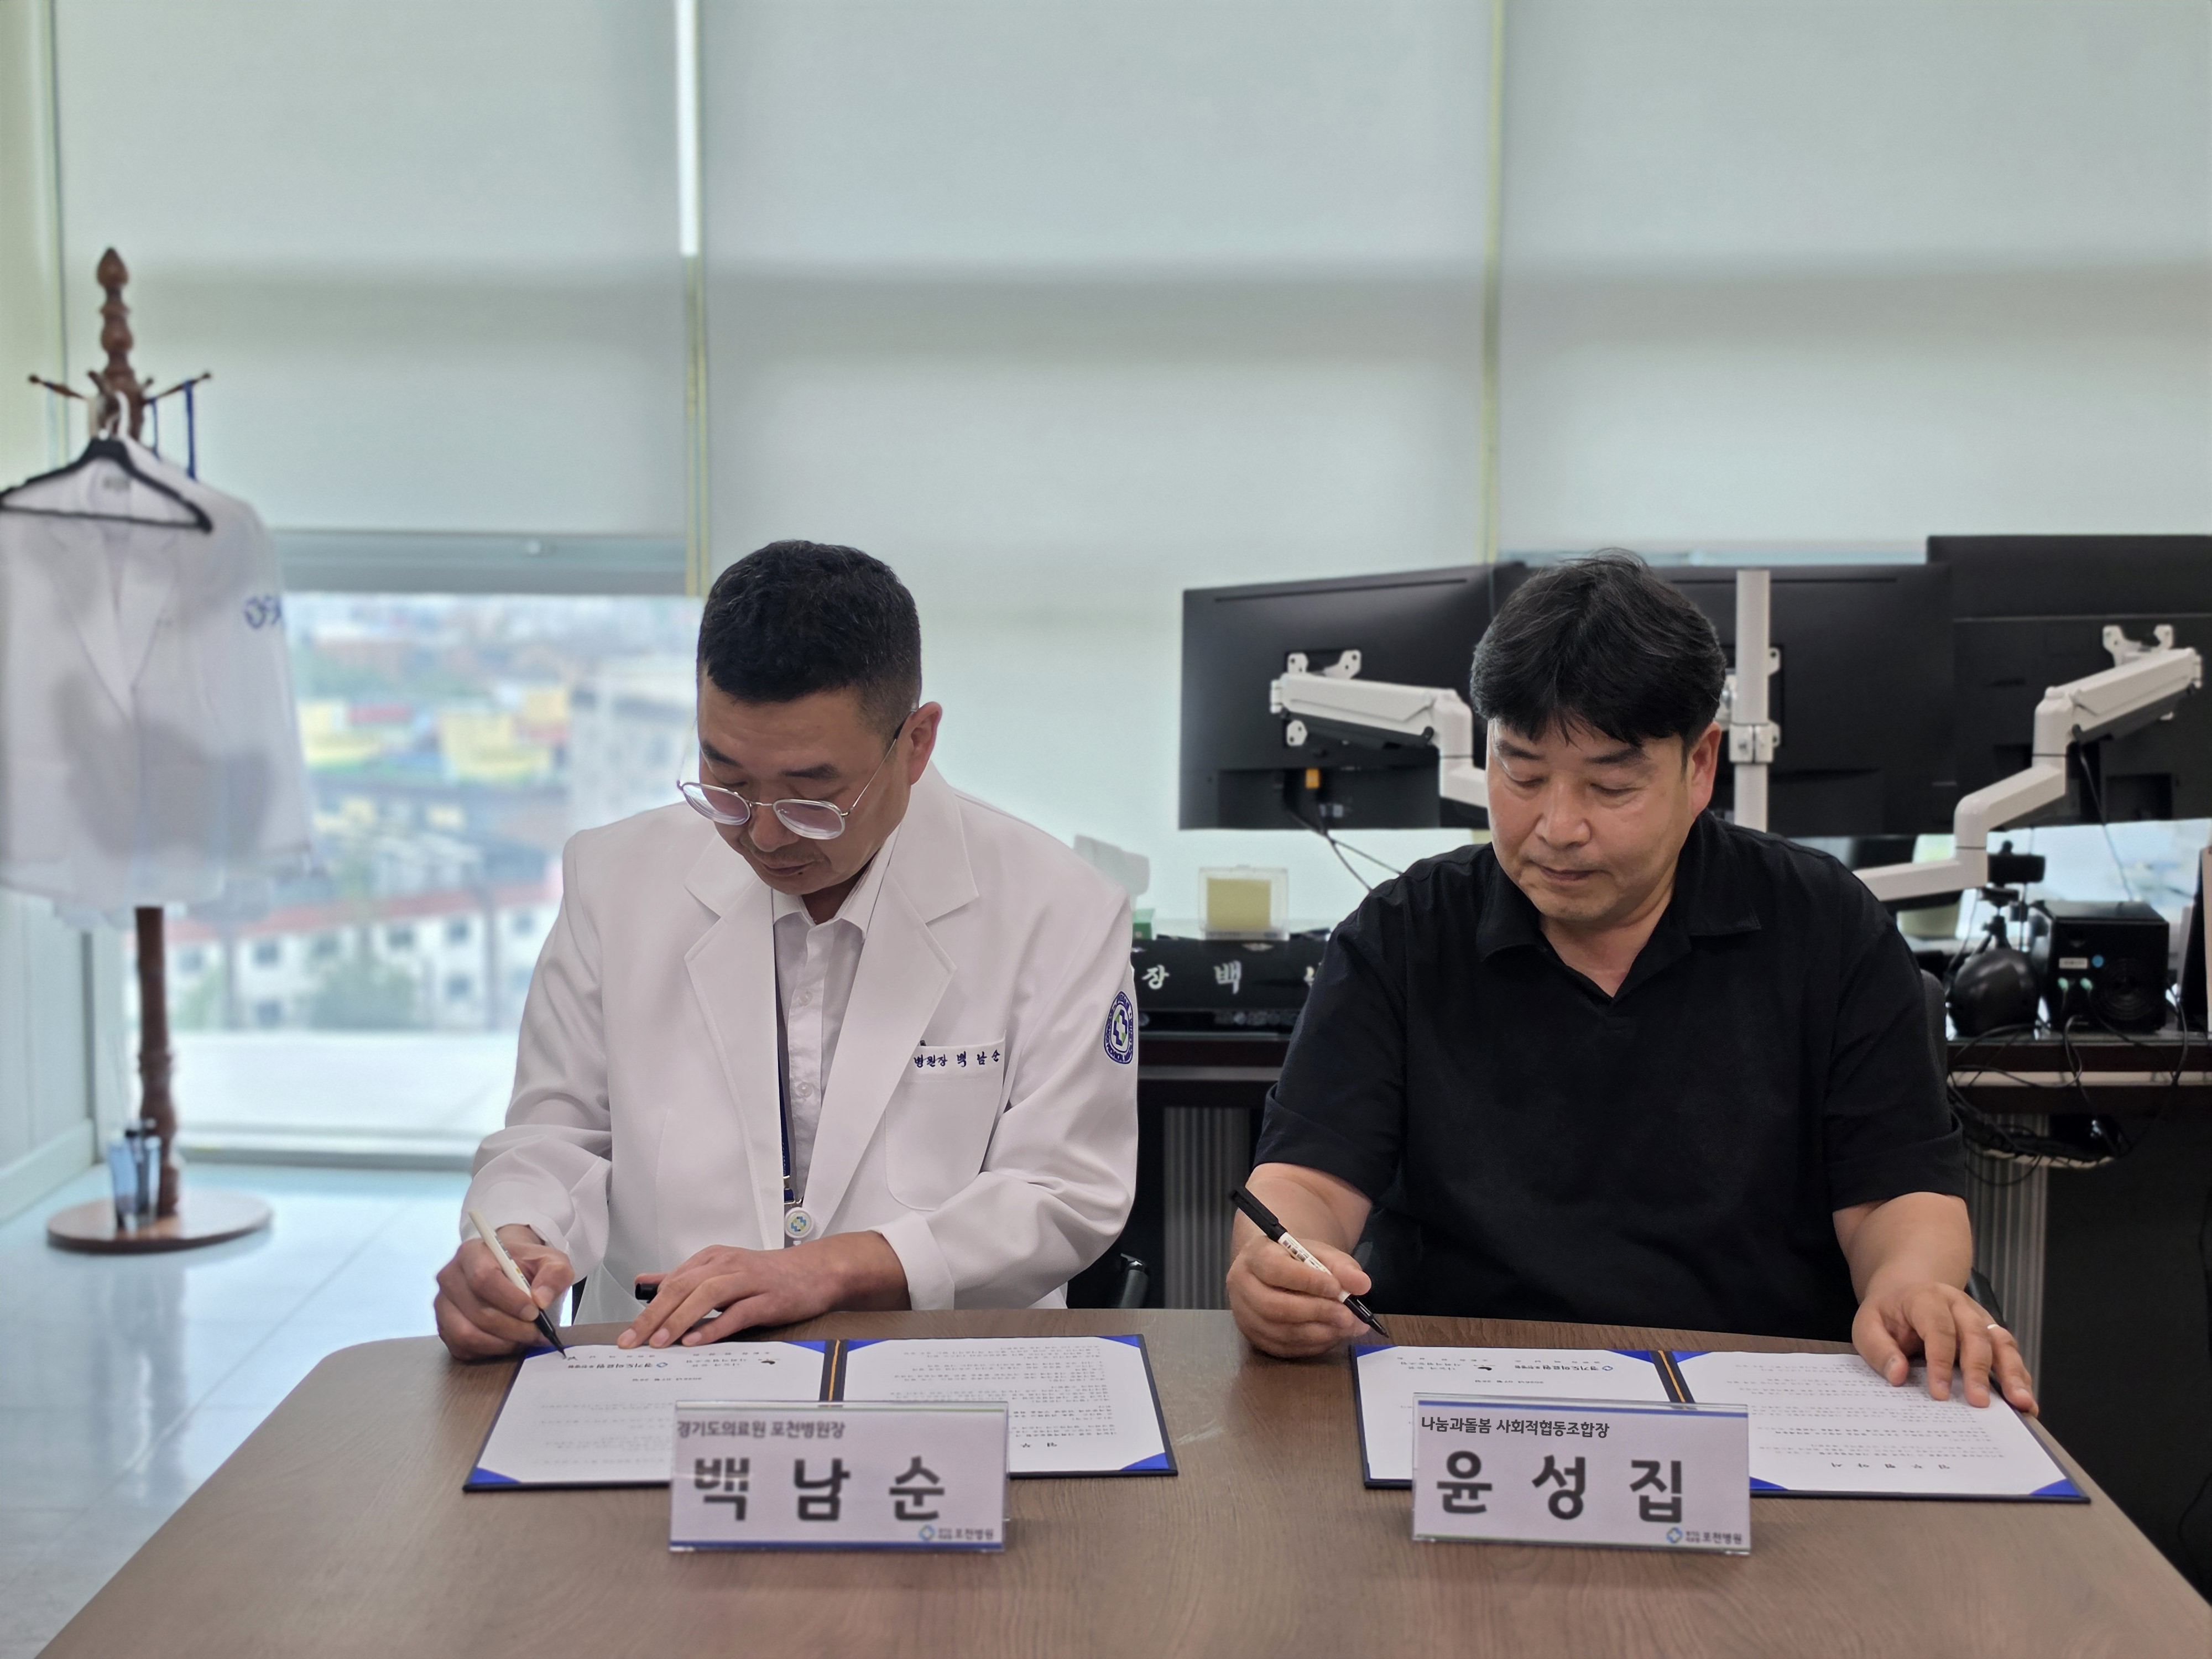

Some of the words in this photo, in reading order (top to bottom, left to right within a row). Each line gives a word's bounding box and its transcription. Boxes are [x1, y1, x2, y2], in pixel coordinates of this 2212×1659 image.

[1141, 964, 1170, 990] 장
[913, 1053, 948, 1068] 병원장
[956, 1050, 967, 1068] 백
[977, 1051, 988, 1065] 남
[991, 1050, 1000, 1062] 순
[677, 1421, 766, 1438] 경기도의료원
[771, 1420, 846, 1439] 포천병원장
[1421, 1416, 1492, 1434] 나눔과돌봄
[1496, 1419, 1610, 1438] 사회적협동조합장
[693, 1457, 750, 1522] 백
[793, 1458, 851, 1522] 남
[888, 1455, 945, 1522] 순
[1436, 1450, 1493, 1515] 윤
[1531, 1454, 1586, 1521] 성
[1629, 1459, 1682, 1524] 집
[1703, 1531, 1742, 1545] 포천병원
